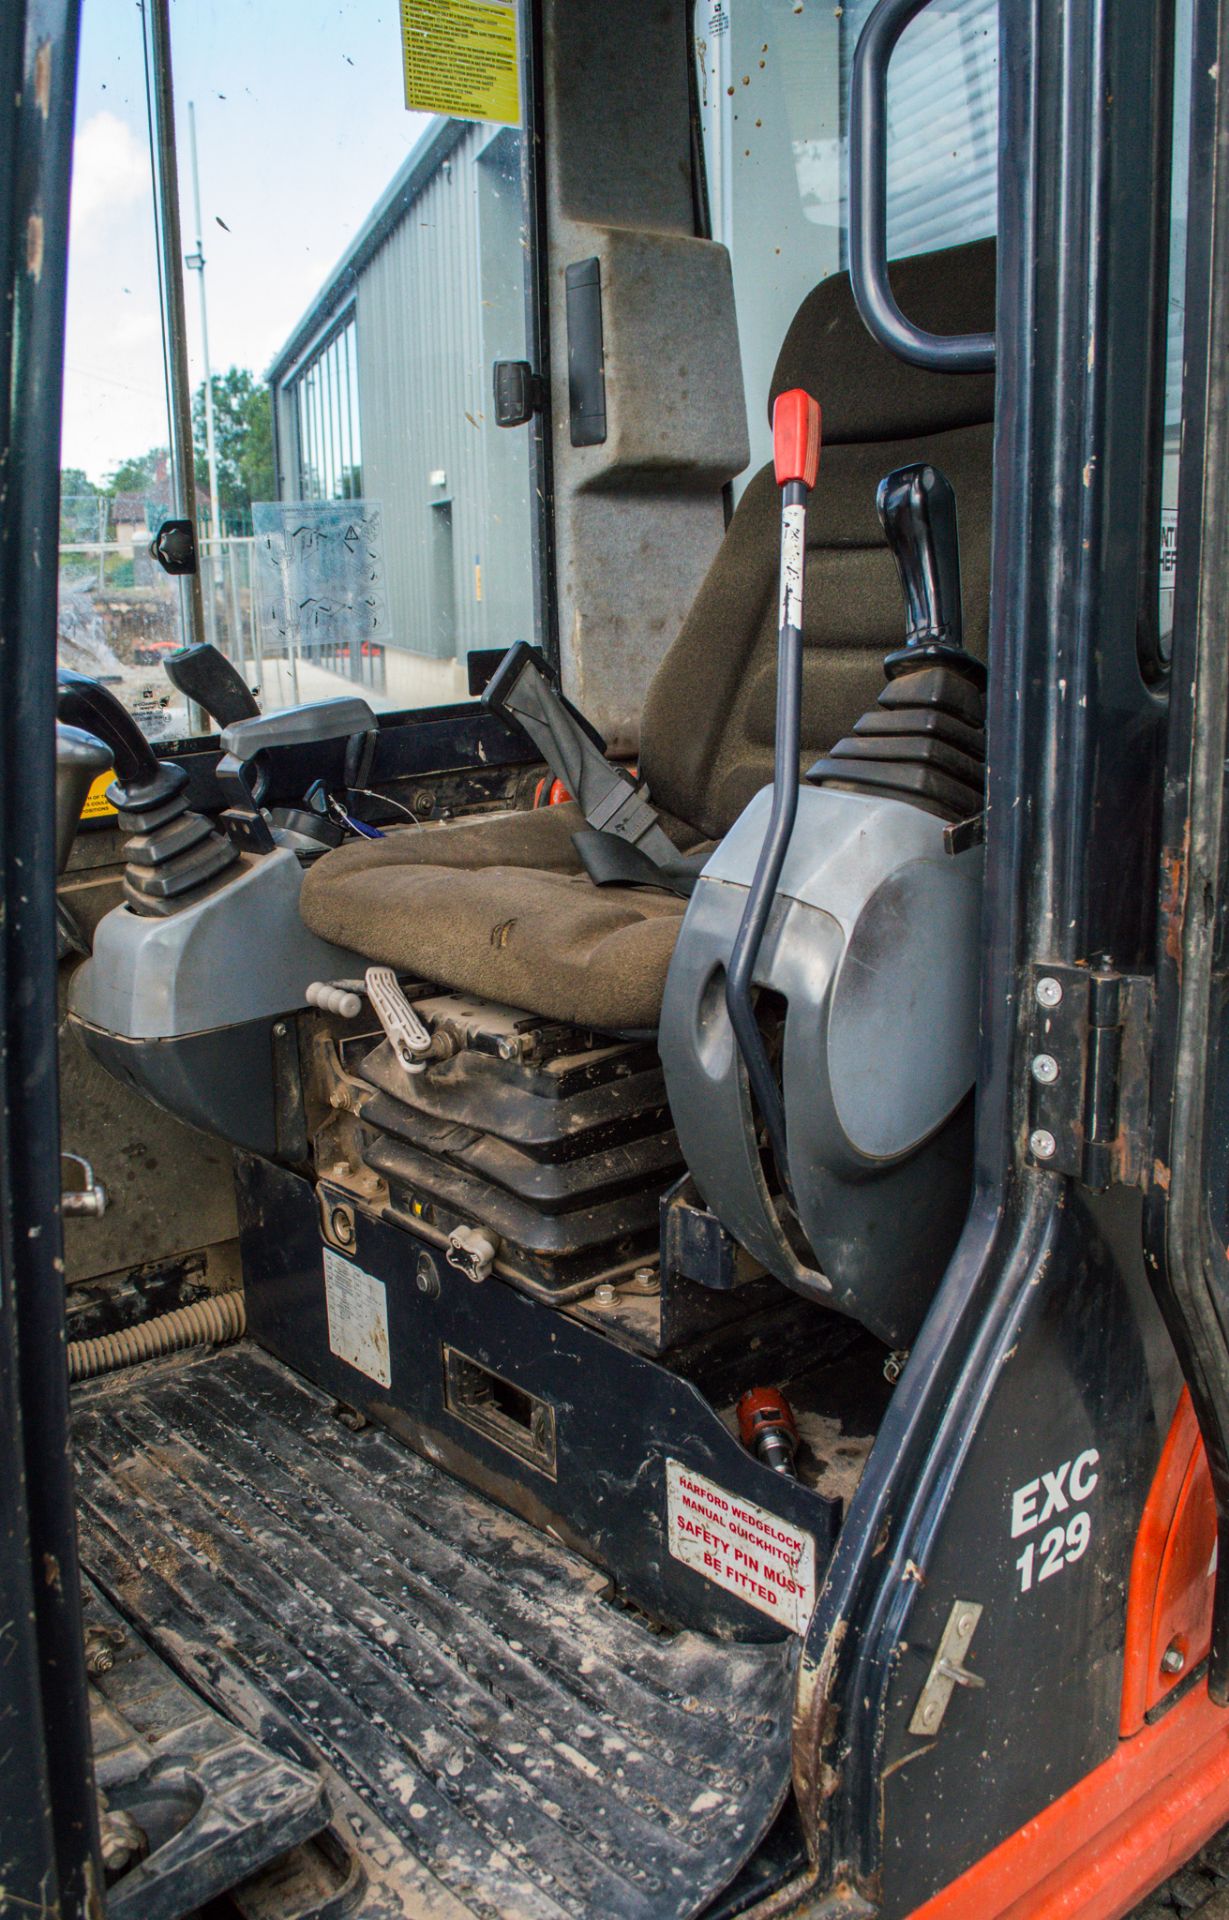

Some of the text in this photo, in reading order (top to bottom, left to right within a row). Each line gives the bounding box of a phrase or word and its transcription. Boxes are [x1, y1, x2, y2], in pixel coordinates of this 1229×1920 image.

[679, 1477, 802, 1551] HARFORD WEDGELOCK
[682, 1495, 799, 1568] MANUAL QUICKHITCH
[1011, 1448, 1100, 1538] EXC
[677, 1515, 806, 1599] SAFETY PIN MUST
[703, 1552, 777, 1605] BE FITTED
[1016, 1511, 1091, 1593] 129
